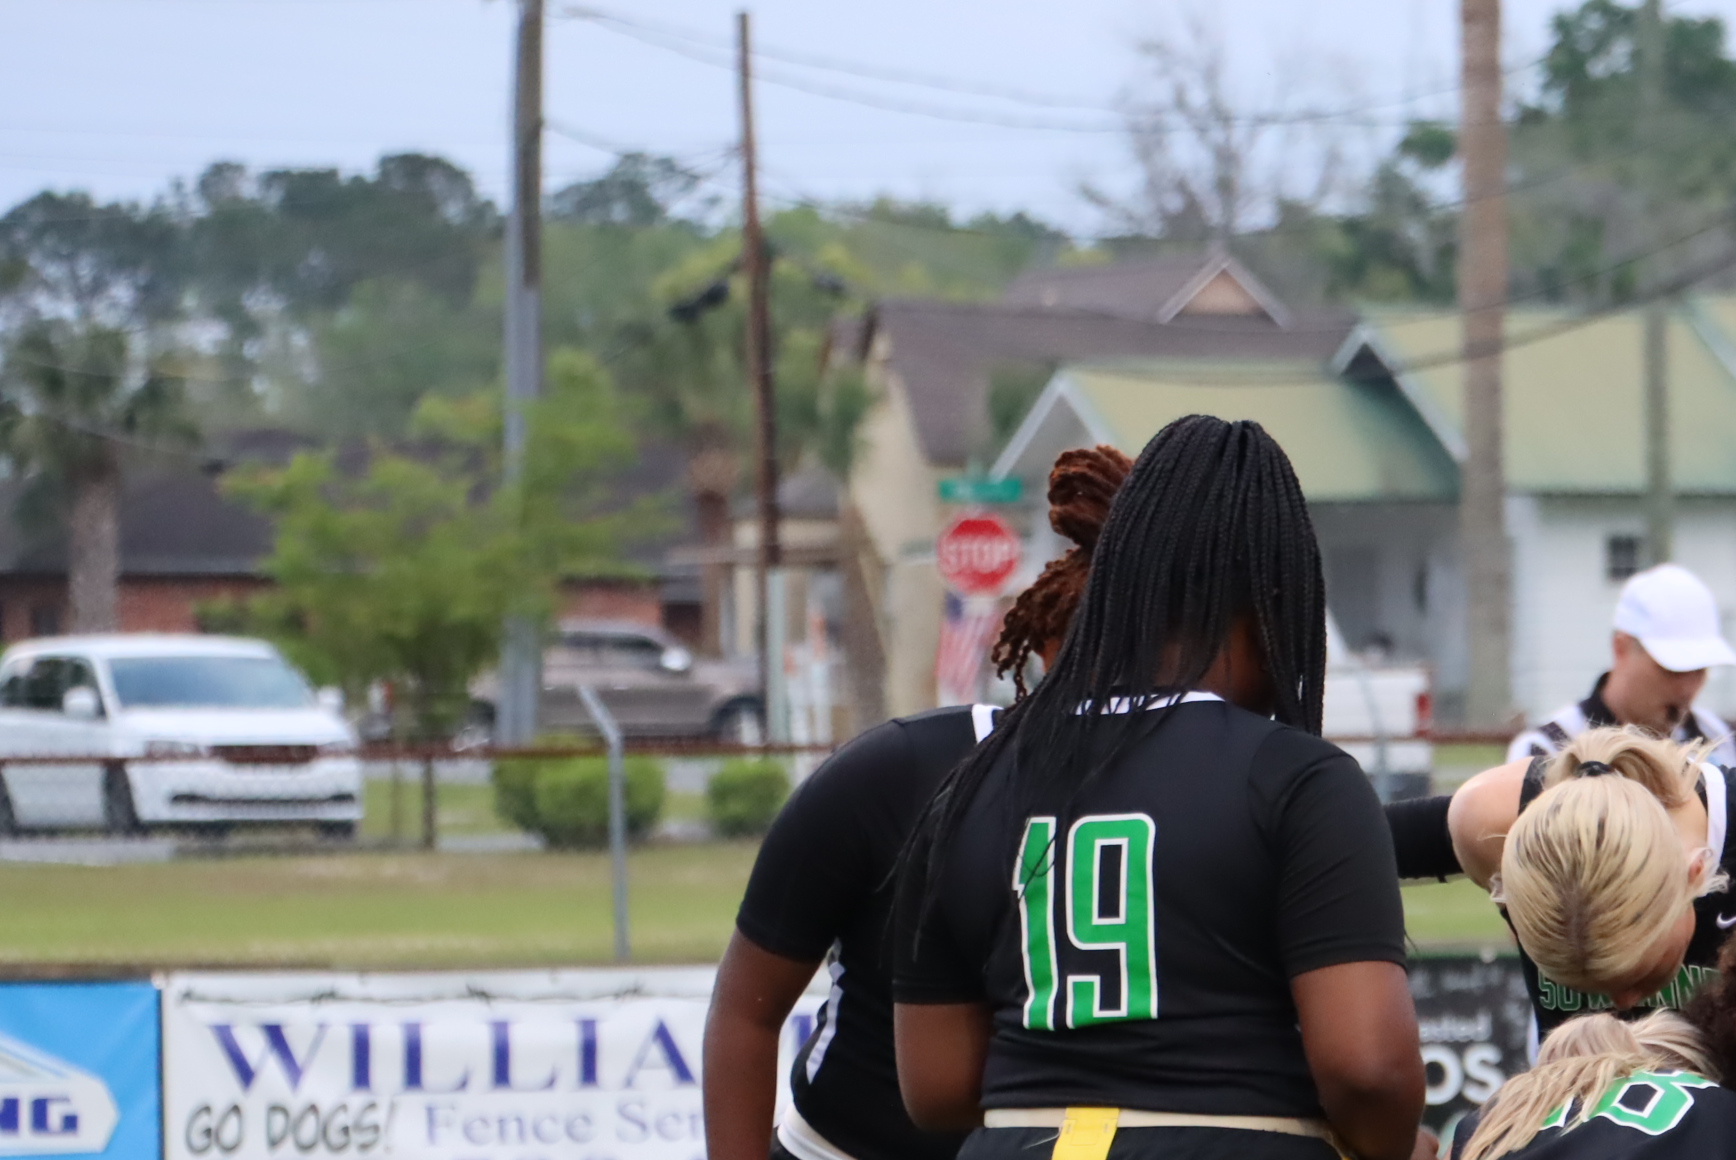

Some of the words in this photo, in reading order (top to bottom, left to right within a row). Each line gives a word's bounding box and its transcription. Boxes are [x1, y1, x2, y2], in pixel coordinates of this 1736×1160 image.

[1012, 813, 1158, 1031] 19
[208, 1018, 701, 1094] WILLIA
[186, 1104, 245, 1155] GO
[266, 1100, 397, 1156] DOGS!
[424, 1103, 596, 1147] Fence
[613, 1100, 704, 1144] Ser
